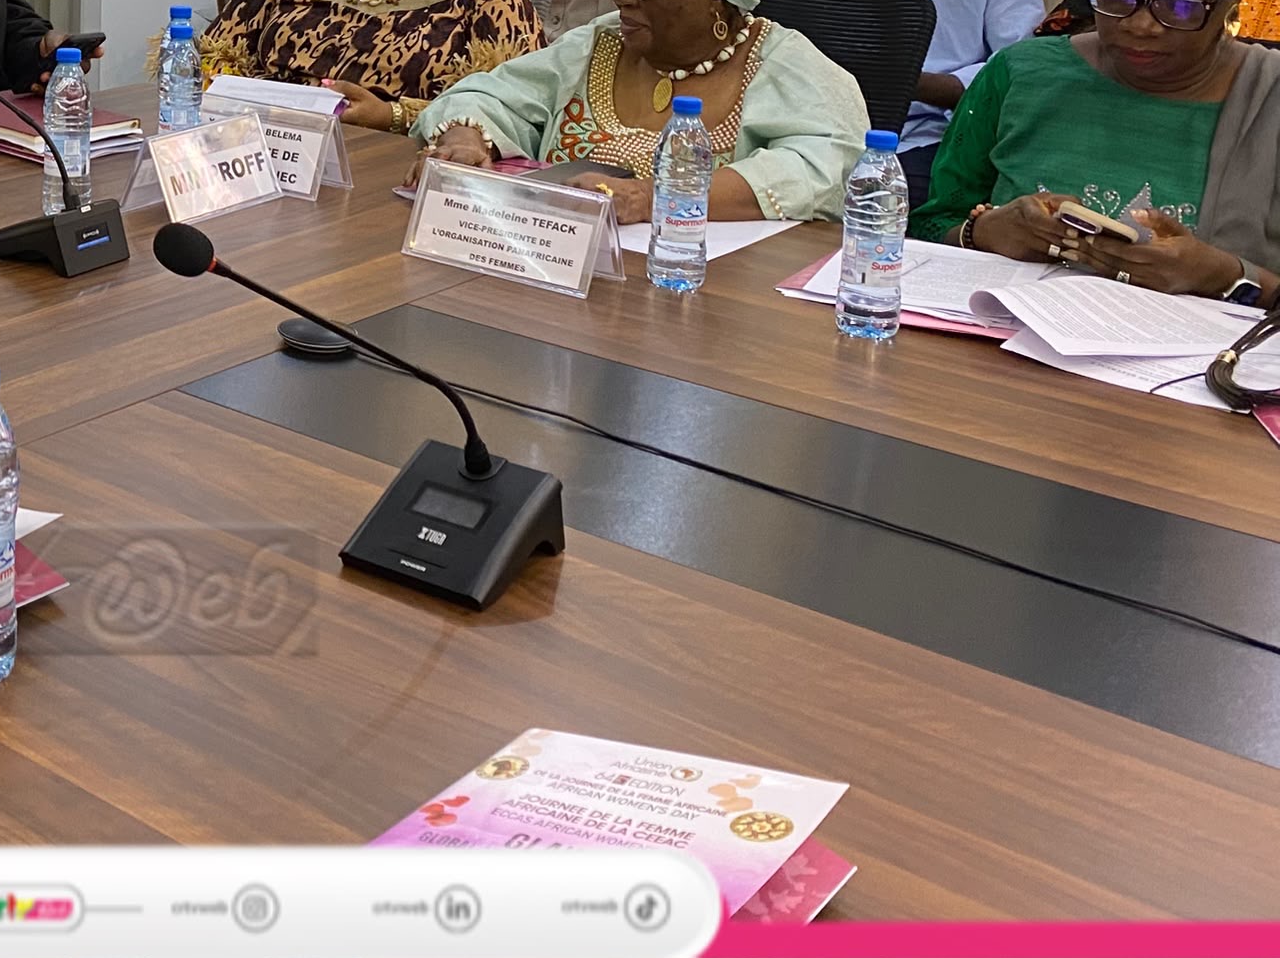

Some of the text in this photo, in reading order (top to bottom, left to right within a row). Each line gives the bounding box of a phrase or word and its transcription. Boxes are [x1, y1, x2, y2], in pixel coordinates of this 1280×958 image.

[266, 128, 302, 142] BELEMA
[282, 150, 299, 163] DE
[444, 198, 577, 235] Mme Madeleine TEFACK
[432, 228, 573, 267] L'ORGANISATION PANAFRICAINE
[459, 220, 551, 247] VICE-PRESIDENTE DE
[469, 253, 526, 272] DES FEMMES
[546, 781, 701, 822] AFRICAN WOMEN'S DAY
[627, 778, 686, 796] EDITION
[489, 808, 537, 825] ECCAS
[534, 819, 598, 840] AFRICAN
[502, 798, 690, 849] AFRICAINE DE LA CEEAC
[518, 793, 697, 840] JOURNEE DE LA FEMME
